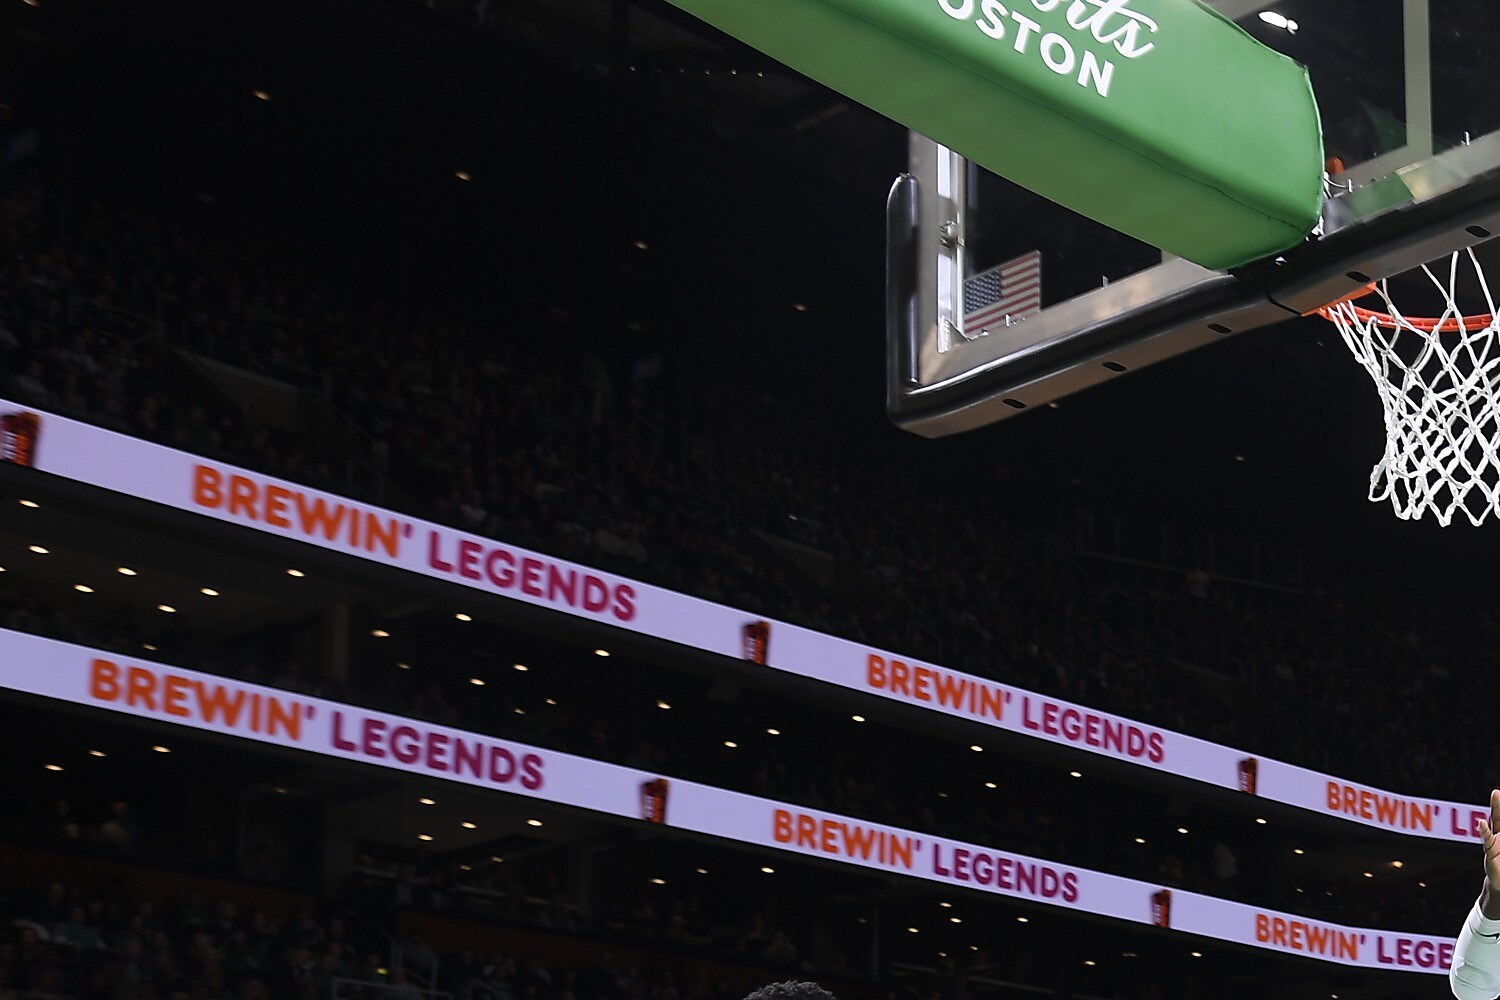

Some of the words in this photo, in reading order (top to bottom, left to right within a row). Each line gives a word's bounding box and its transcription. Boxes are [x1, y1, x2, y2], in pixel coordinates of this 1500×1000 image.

[193, 465, 412, 557] BREWIN'
[429, 532, 636, 621] LEGENDS
[90, 659, 314, 740] BREWIN'
[333, 714, 542, 789] LEGENDS
[867, 654, 1011, 720] BREWIN'
[1023, 698, 1164, 763] LEGENDS
[773, 809, 921, 868] BREWIN'
[934, 846, 1078, 901] LEGENDS
[1327, 782, 1439, 831] BREWIN'
[1256, 914, 1366, 960] BREWIN'
